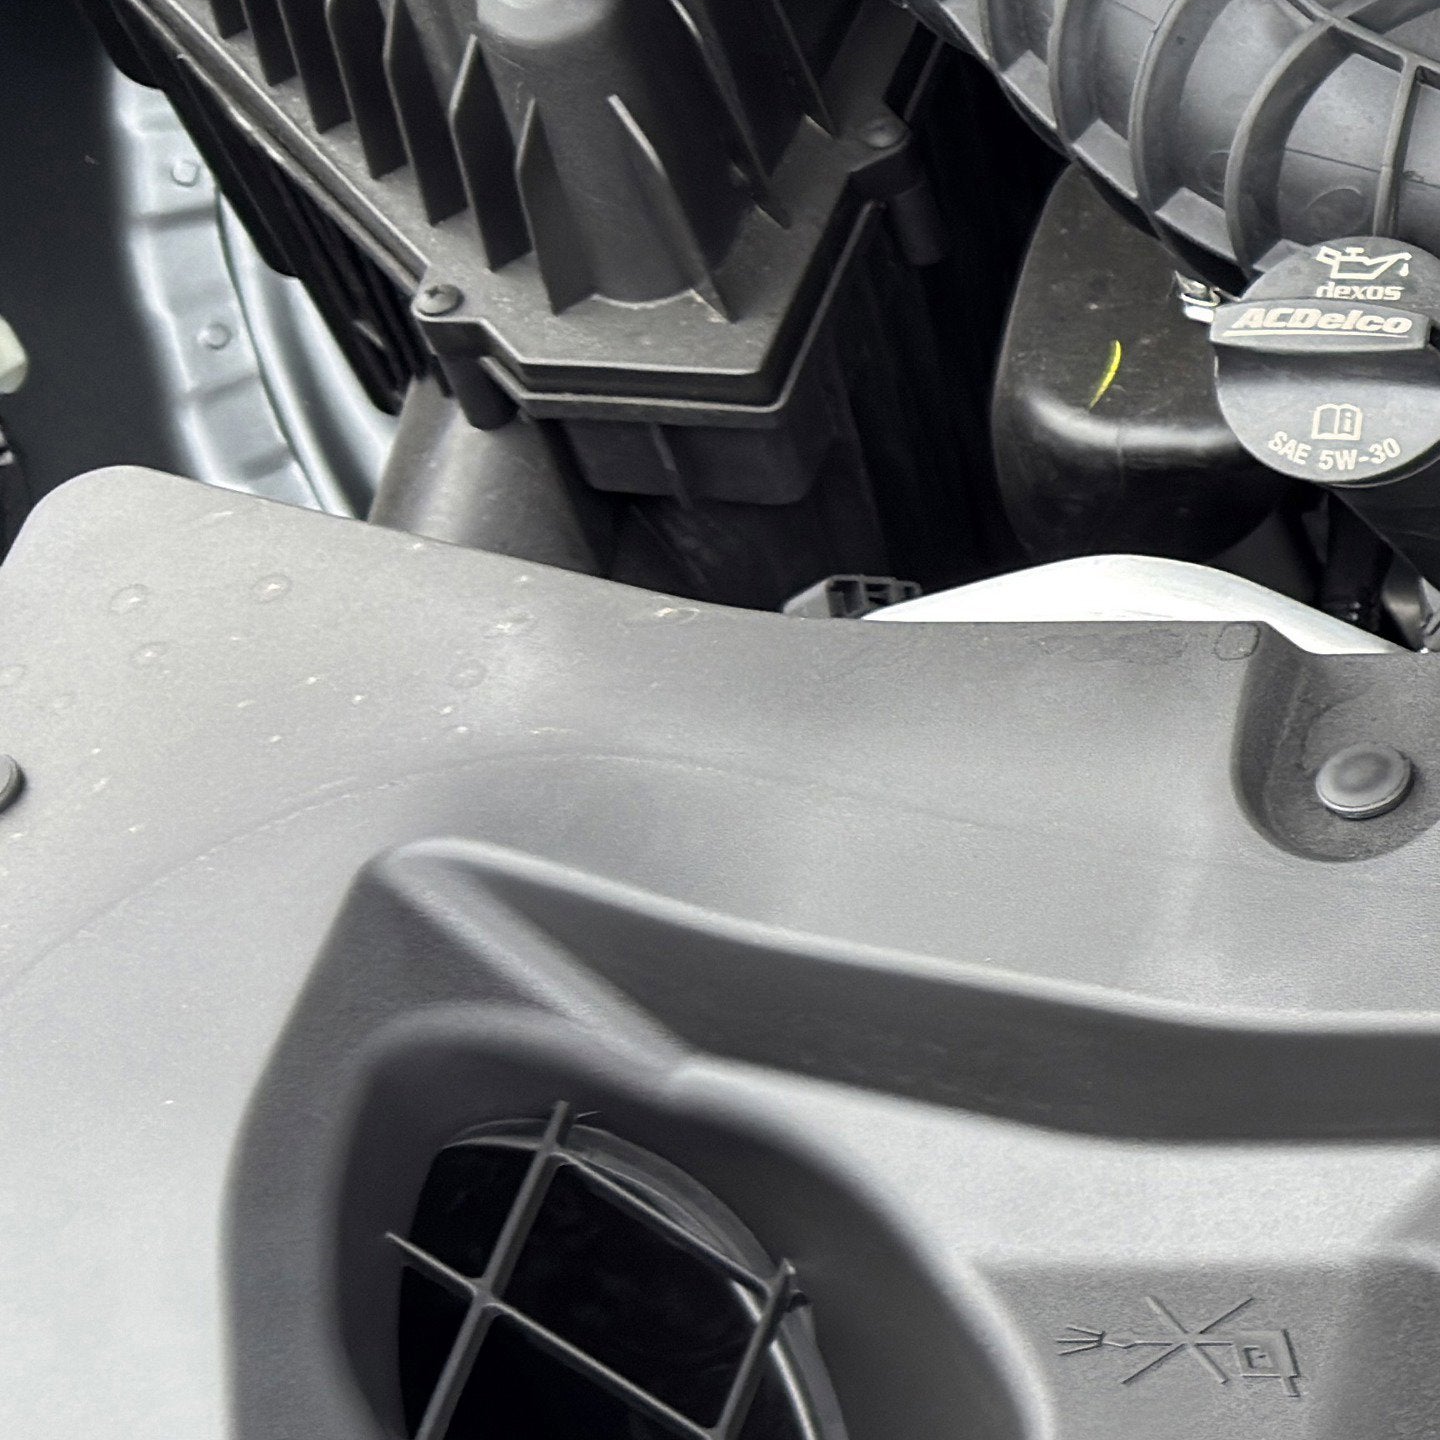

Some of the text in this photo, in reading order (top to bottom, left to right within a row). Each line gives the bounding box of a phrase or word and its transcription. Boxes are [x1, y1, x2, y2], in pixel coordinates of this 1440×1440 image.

[1316, 281, 1404, 301] dexos
[1231, 308, 1413, 334] ACDelco
[1269, 431, 1402, 470] SAE 5W-30
